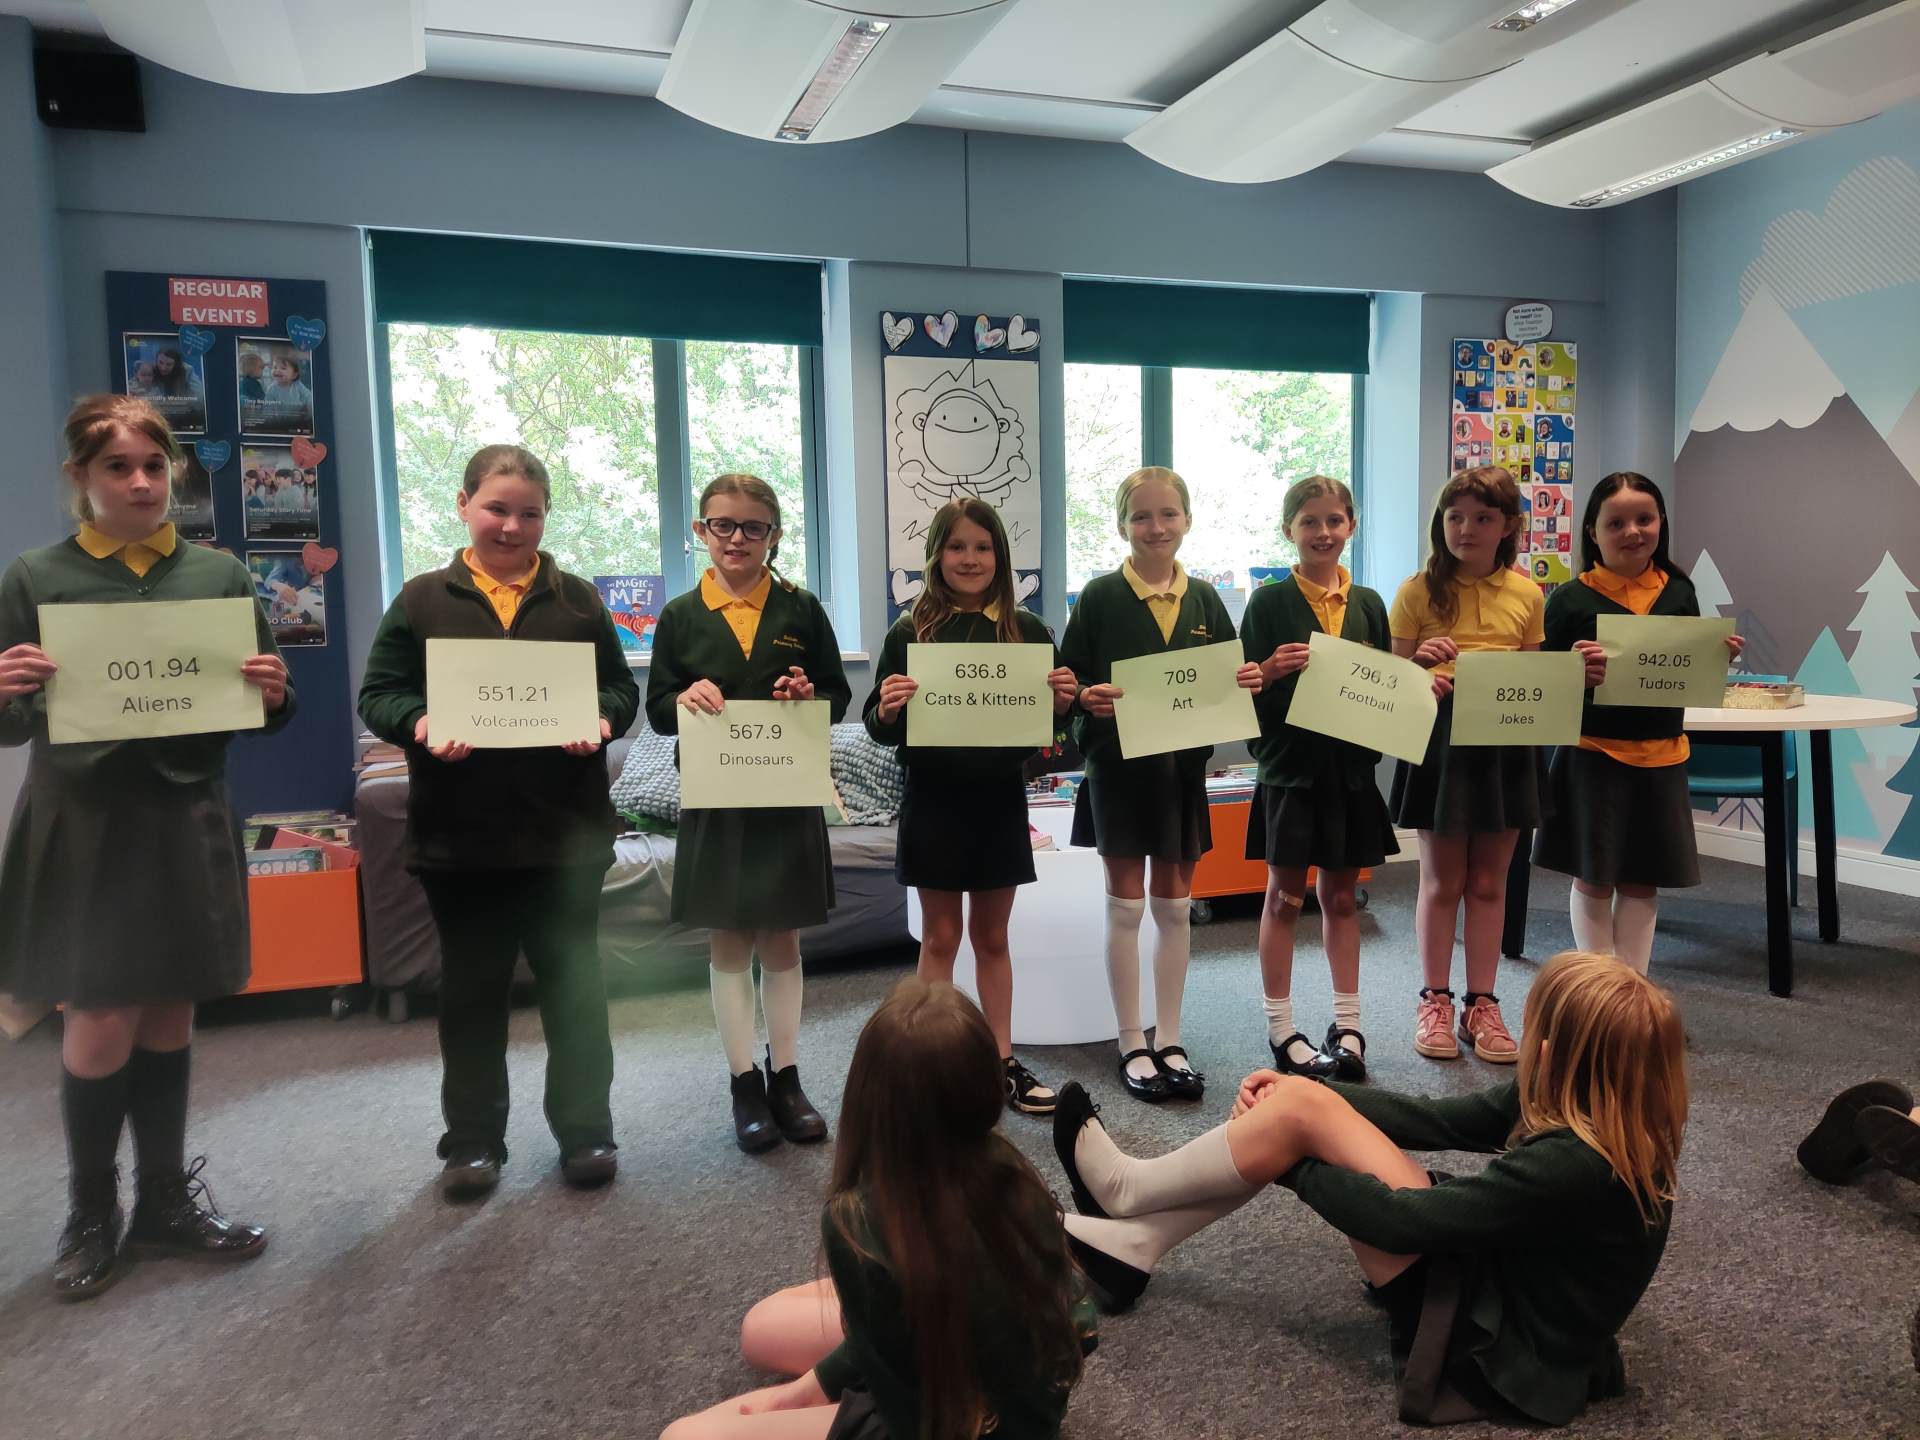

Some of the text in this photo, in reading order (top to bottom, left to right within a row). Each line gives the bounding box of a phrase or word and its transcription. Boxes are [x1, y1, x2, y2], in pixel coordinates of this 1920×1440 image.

[173, 281, 263, 298] REGULAR
[182, 307, 257, 324] EVENTS
[615, 578, 649, 588] MAGIC
[609, 588, 652, 606] ME!
[107, 656, 201, 681] 001.94
[1638, 653, 1691, 668] 942.05
[955, 663, 1007, 679] 636.8
[1163, 667, 1197, 686] 709
[1350, 661, 1398, 690] 796.3
[1639, 677, 1686, 691] Tudors
[478, 685, 548, 702] 551.21
[924, 691, 1036, 706] Cats & Kittens
[1339, 684, 1395, 713] Football
[1495, 687, 1543, 702] 828.9
[121, 695, 193, 715] Aliens
[1172, 696, 1194, 711] Art
[471, 714, 559, 728] Volcanoes
[1499, 713, 1535, 725] Jokes
[729, 723, 782, 740] 567.9
[719, 752, 794, 766] Dinosaurs
[248, 859, 311, 875] CORNS
